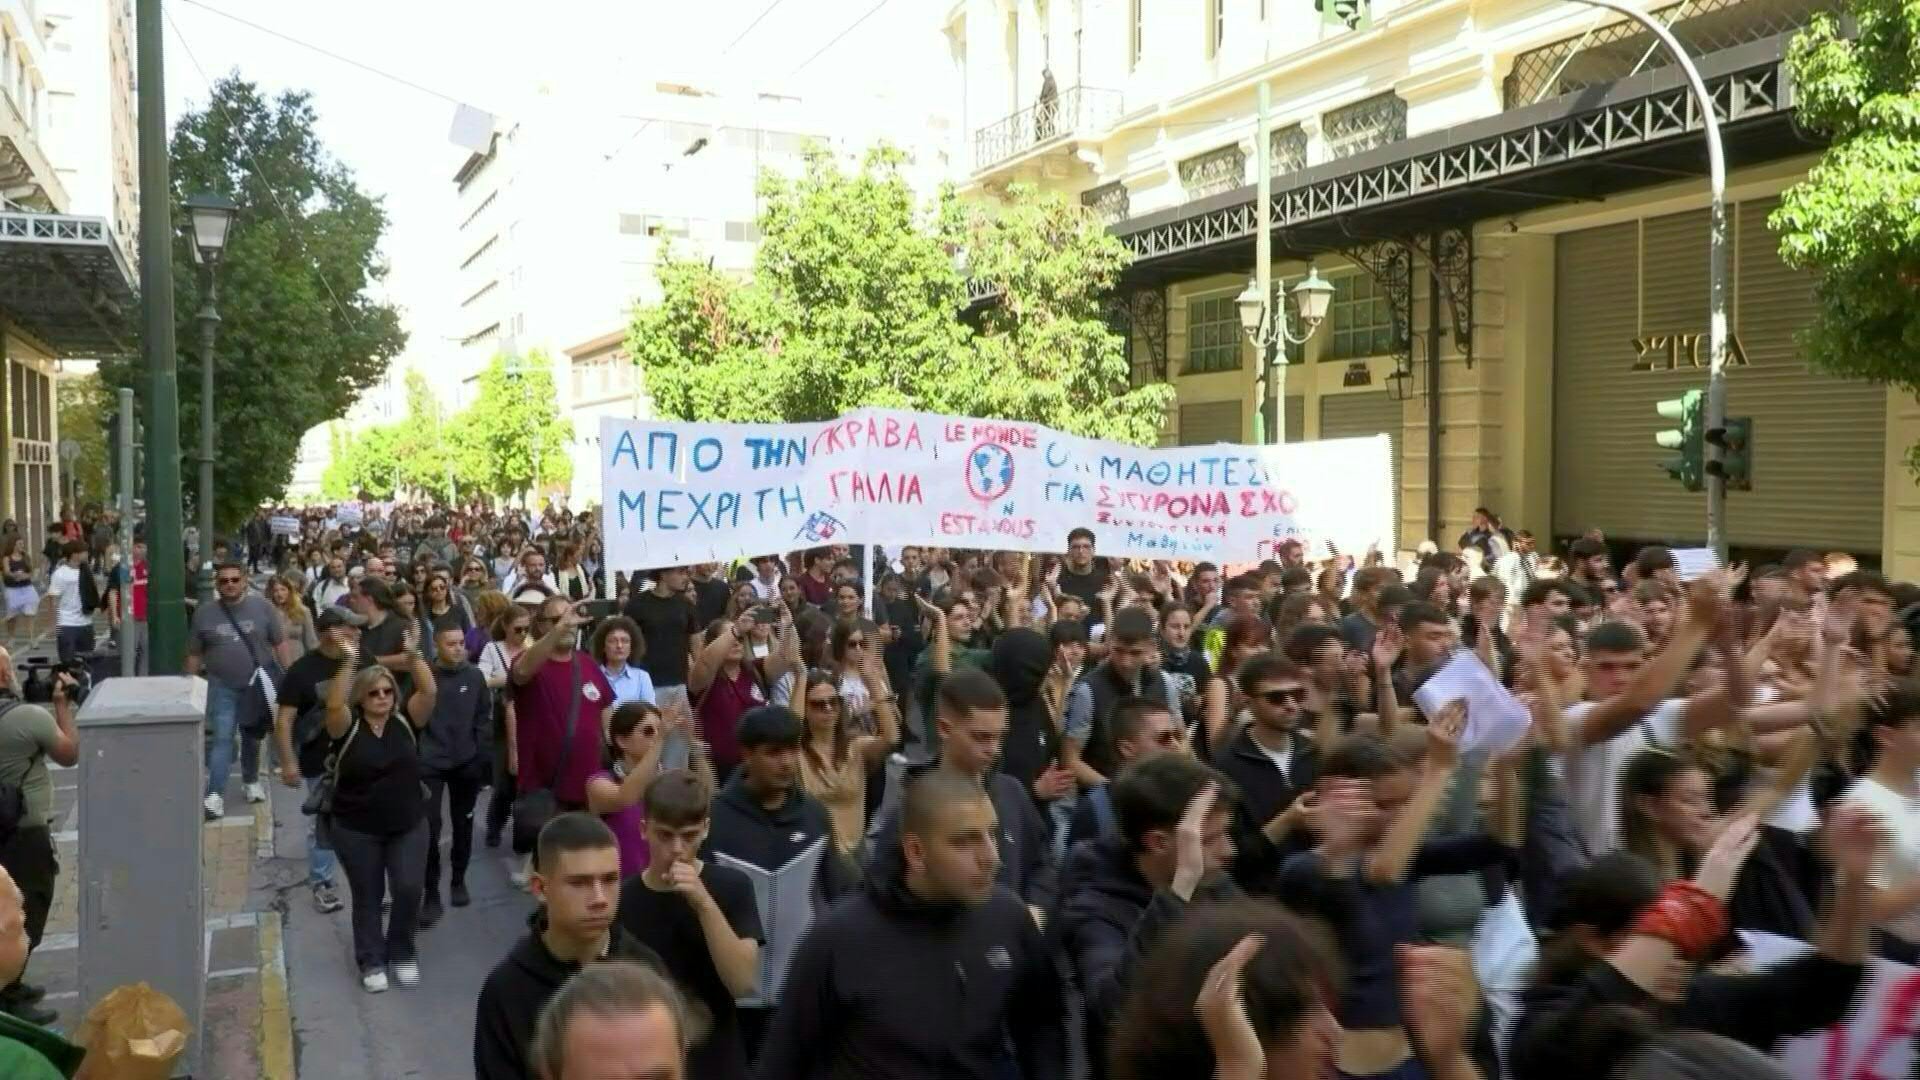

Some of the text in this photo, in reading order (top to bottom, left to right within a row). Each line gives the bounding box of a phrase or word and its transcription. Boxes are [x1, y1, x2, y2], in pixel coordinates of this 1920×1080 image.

[945, 423, 966, 442] LE
[612, 430, 724, 473] ΑΠΟ
[744, 436, 807, 470] ΤΗΝ
[1100, 455, 1263, 487] ΜΑΘΗΤΕΣ
[1045, 481, 1085, 502] ΓΙΑ
[618, 489, 742, 532] ΜΕΧΡΙ
[754, 485, 805, 521] ΤΗ
